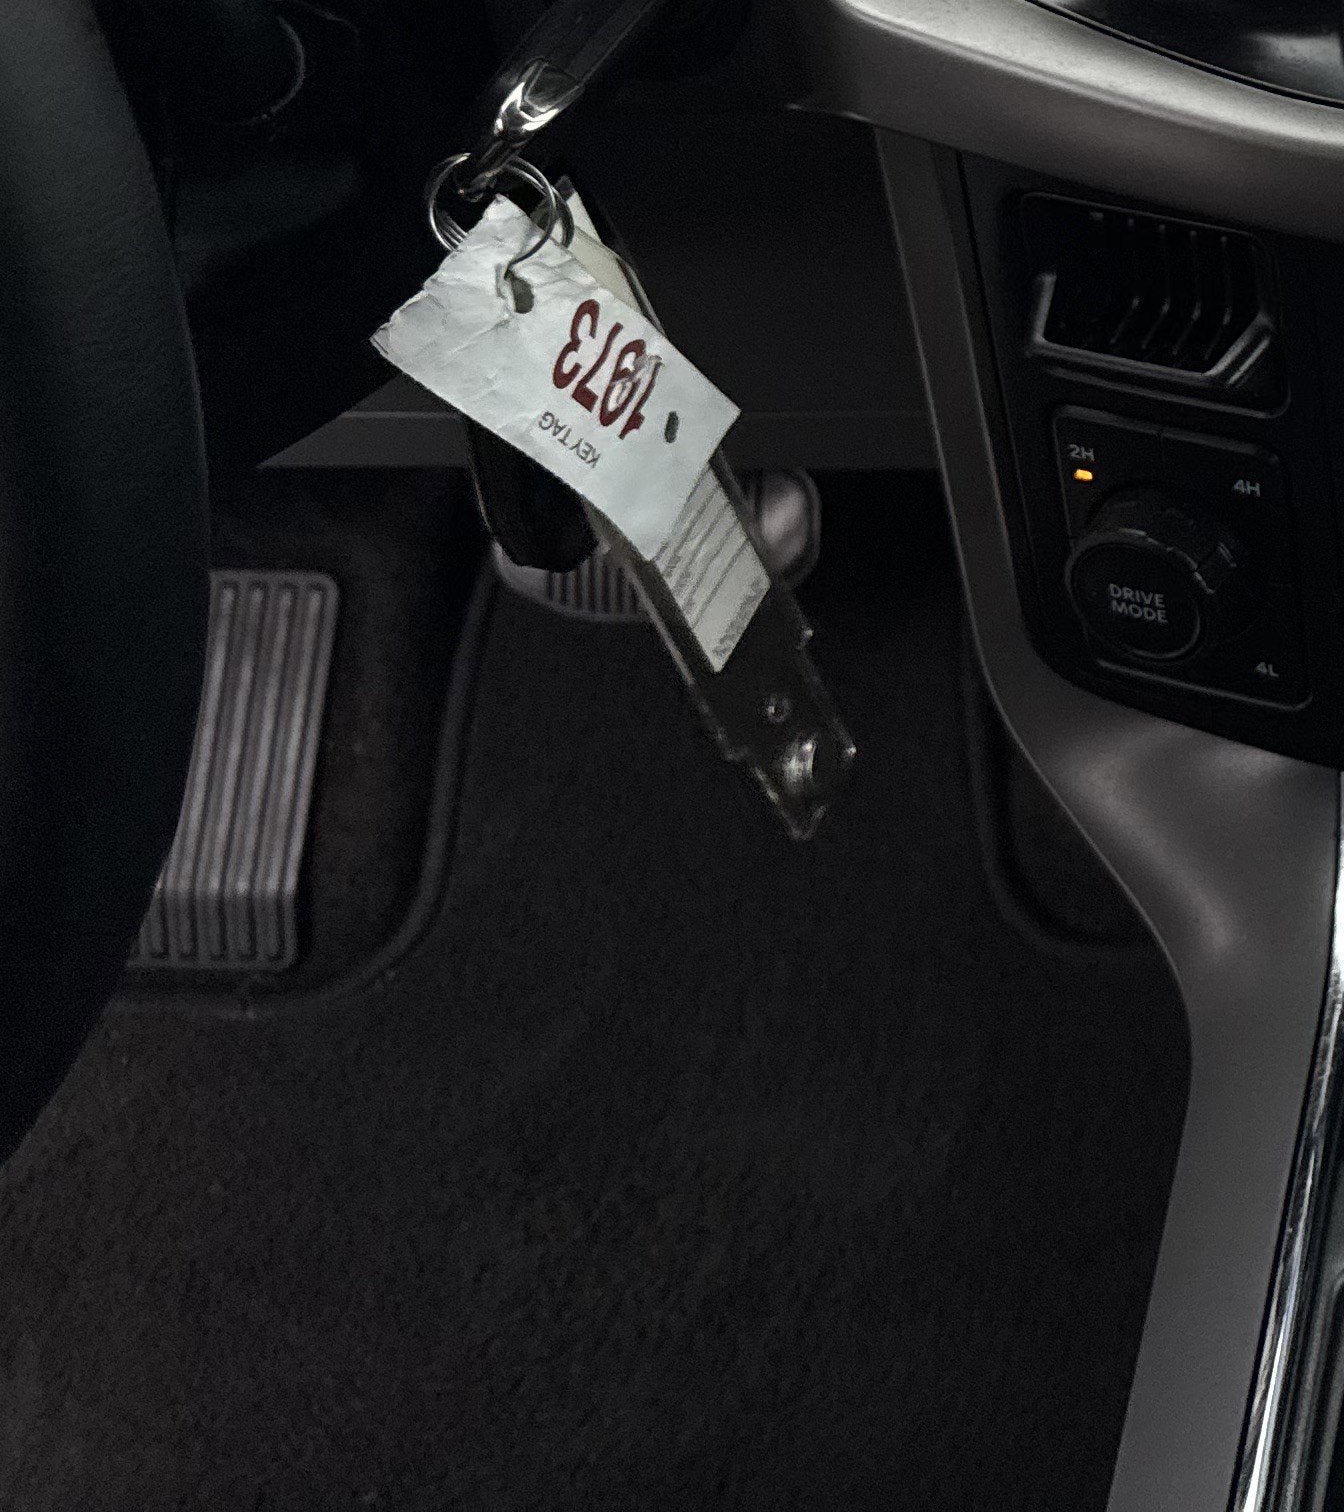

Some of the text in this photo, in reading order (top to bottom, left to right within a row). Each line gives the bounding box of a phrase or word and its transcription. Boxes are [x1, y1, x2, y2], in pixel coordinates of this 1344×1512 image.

[538, 411, 602, 469] KEY TAG
[1068, 443, 1096, 462] 2H
[1231, 479, 1261, 497] 4H
[1109, 583, 1165, 607] DRIVE
[1111, 600, 1168, 624] MODE
[1255, 661, 1280, 678] 4L
